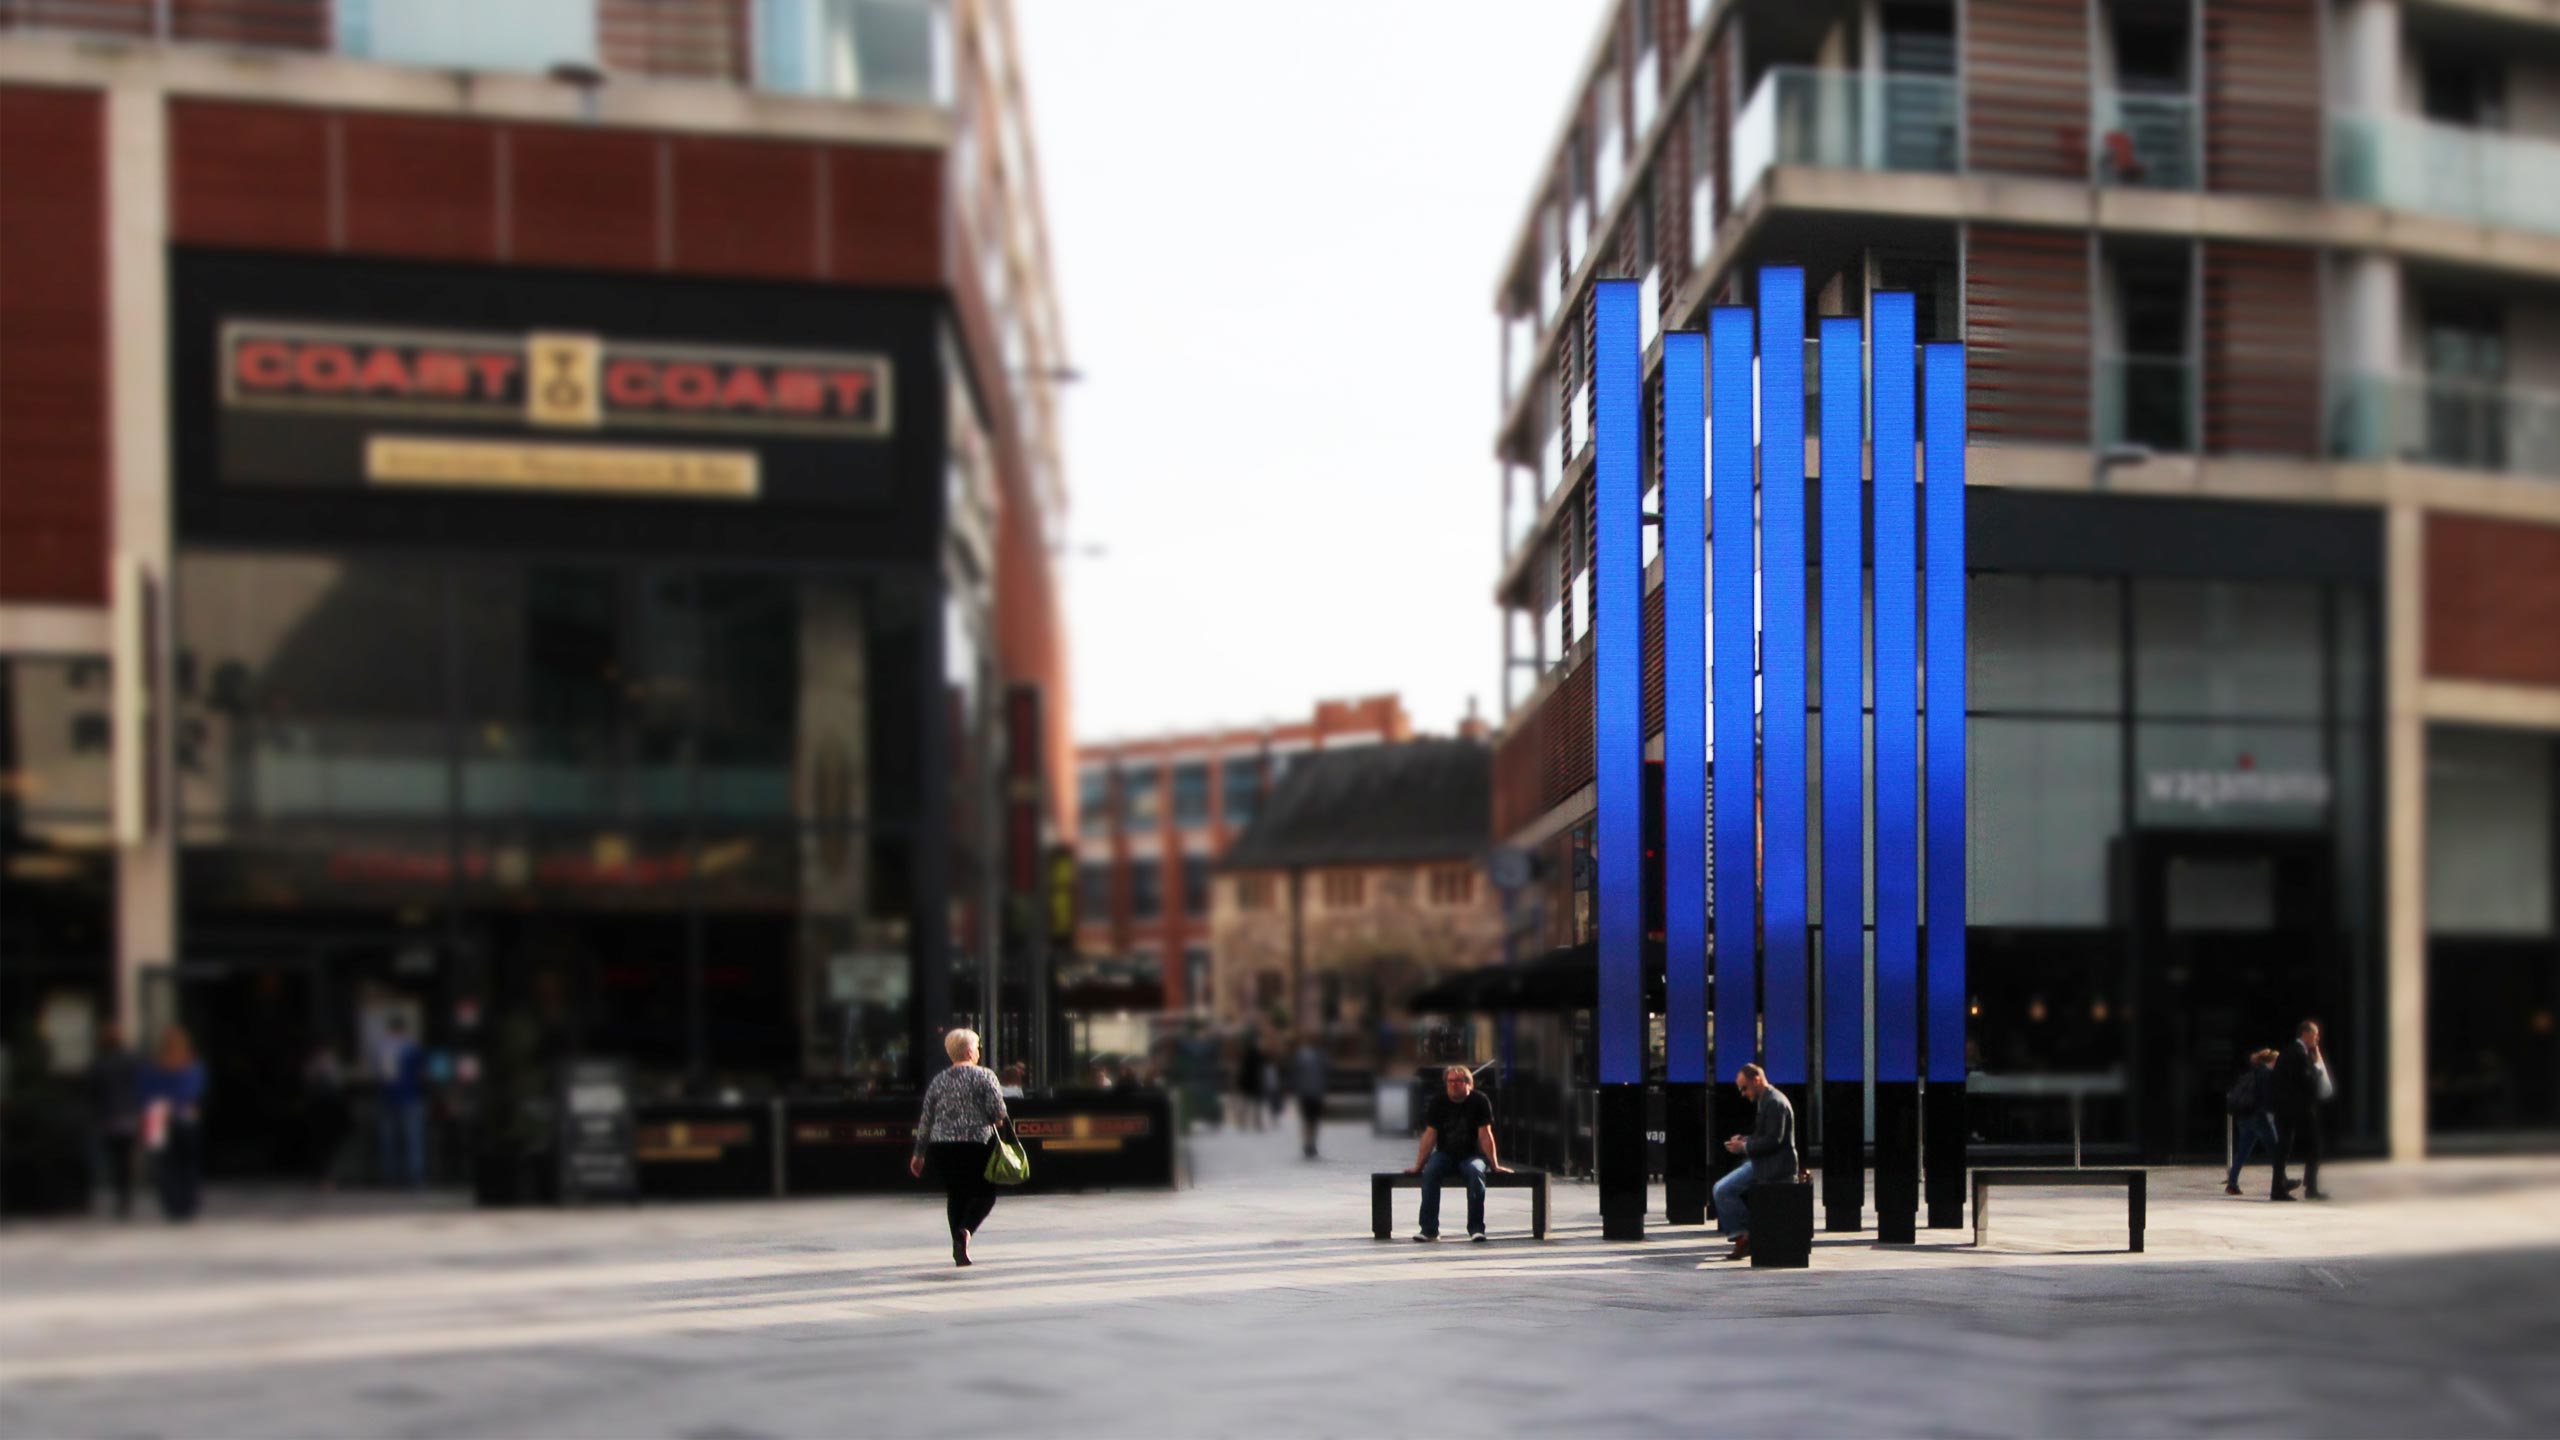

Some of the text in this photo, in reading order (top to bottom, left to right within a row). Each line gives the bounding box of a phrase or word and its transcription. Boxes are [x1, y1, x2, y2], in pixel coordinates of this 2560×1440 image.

[236, 341, 873, 414] COAST TO COAST
